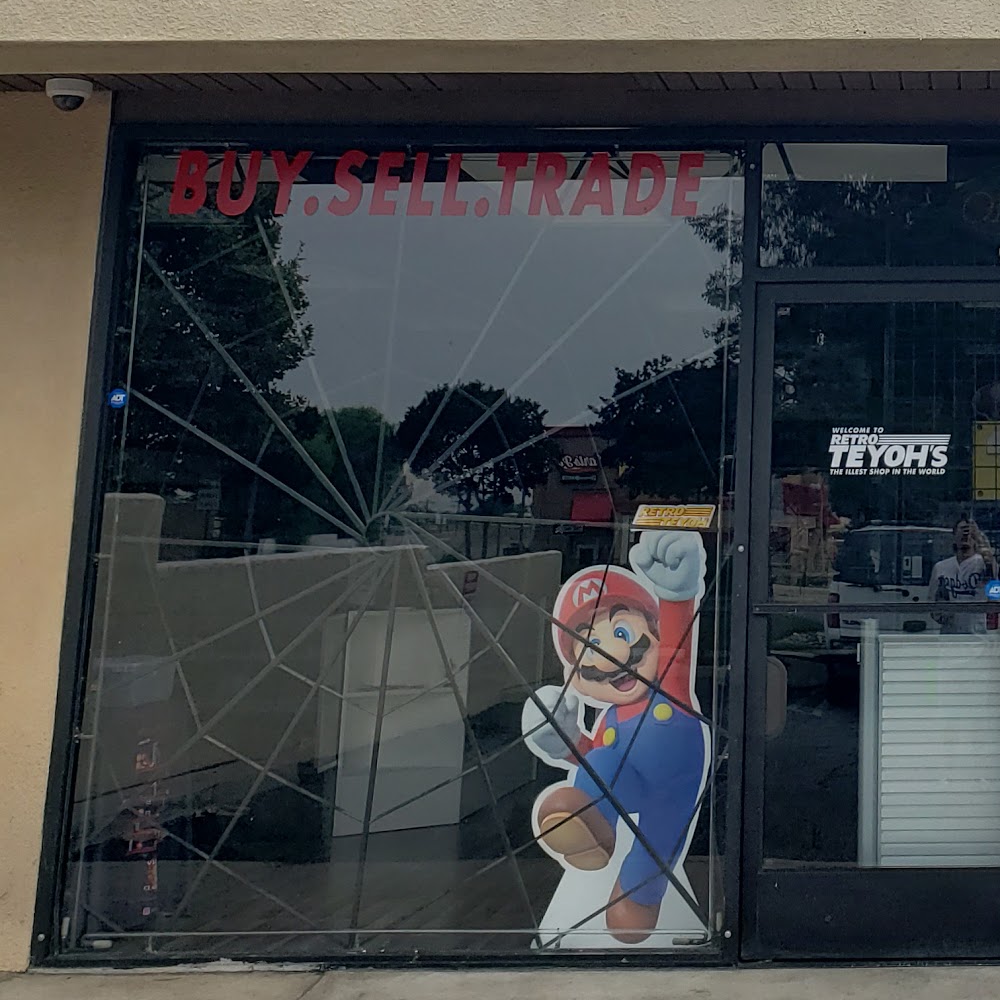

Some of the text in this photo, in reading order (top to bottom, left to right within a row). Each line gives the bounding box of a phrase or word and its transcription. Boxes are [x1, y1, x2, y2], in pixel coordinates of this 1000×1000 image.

[830, 434, 878, 445] RETRO
[828, 445, 948, 468] TEYOH'S
[639, 506, 686, 517] RETRO
